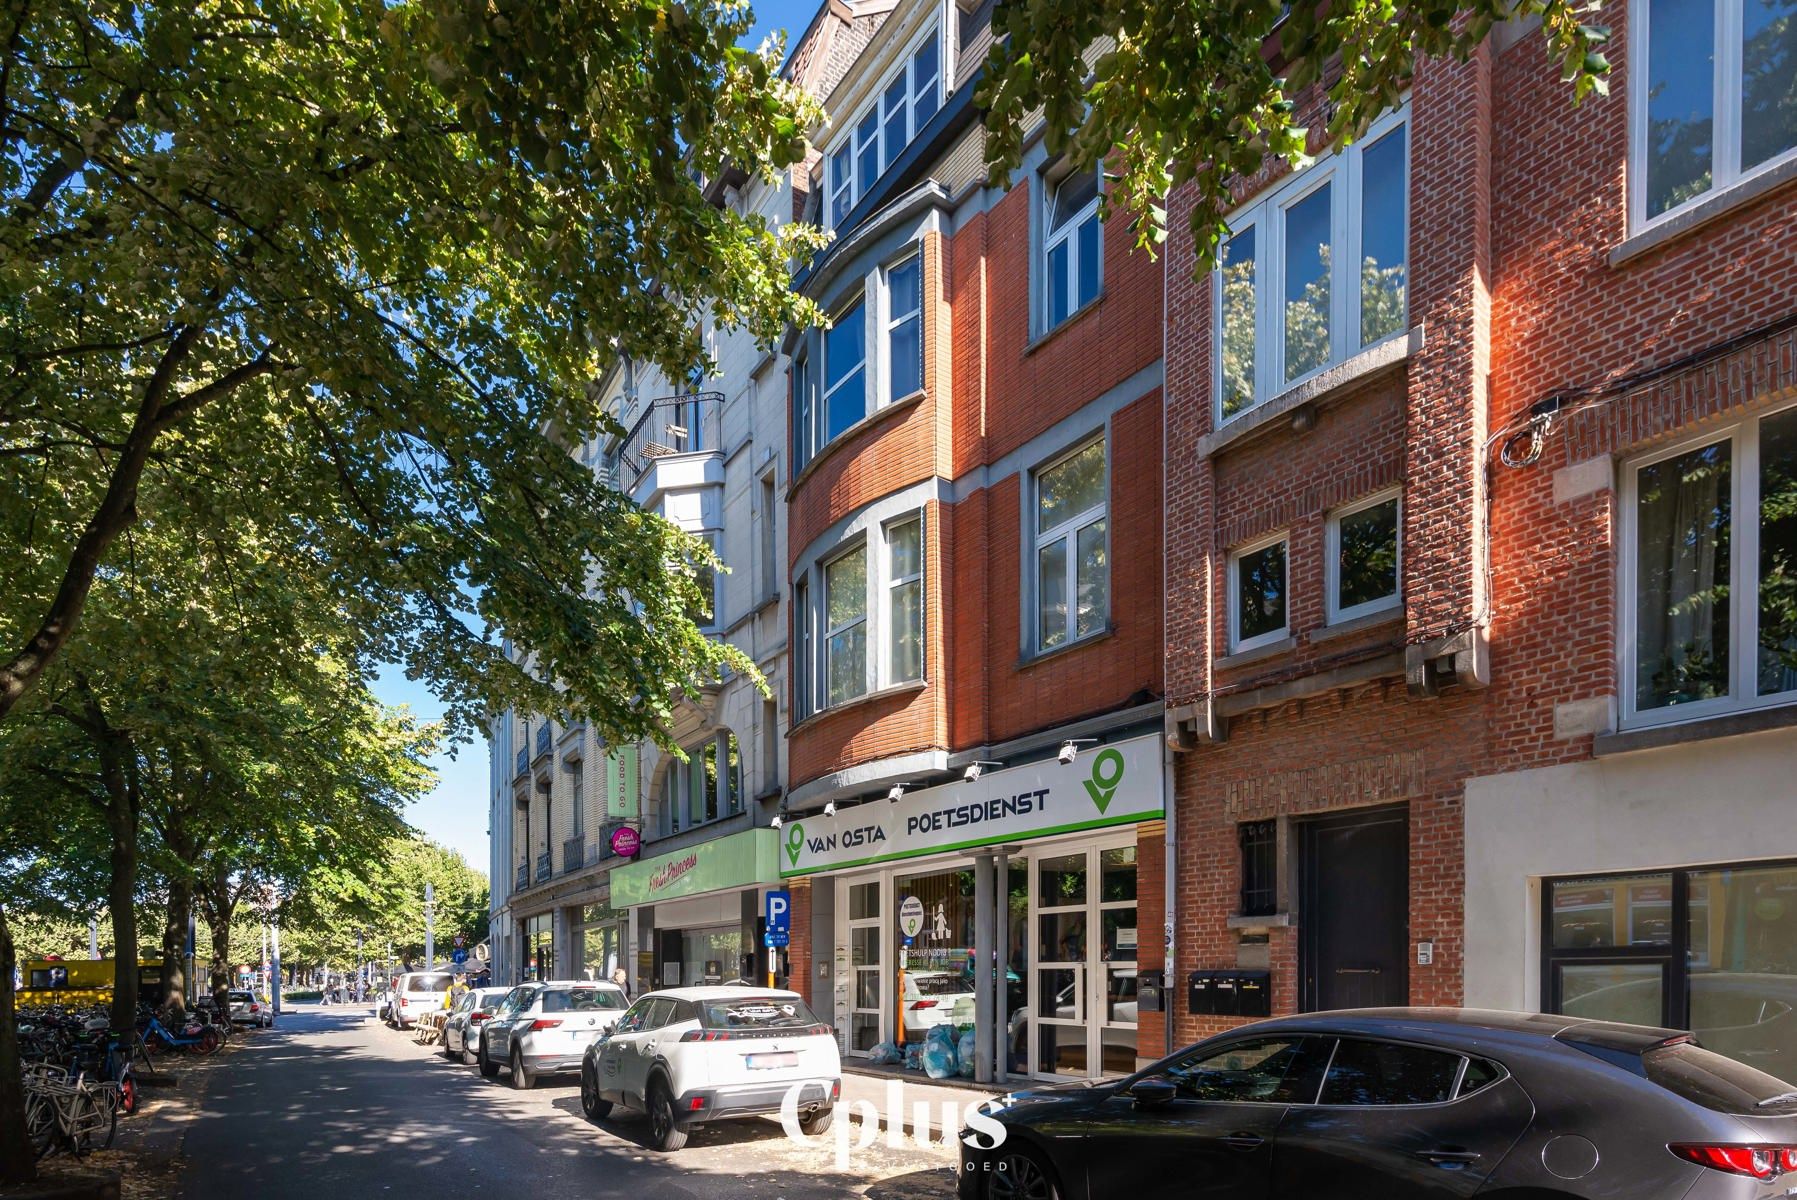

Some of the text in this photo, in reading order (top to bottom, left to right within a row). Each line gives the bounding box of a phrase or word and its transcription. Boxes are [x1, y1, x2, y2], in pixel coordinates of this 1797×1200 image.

[619, 782, 625, 793] TO
[619, 796, 626, 808] GO
[807, 789, 1050, 854] VAN OSTA POETSDIENST
[770, 897, 787, 926] P
